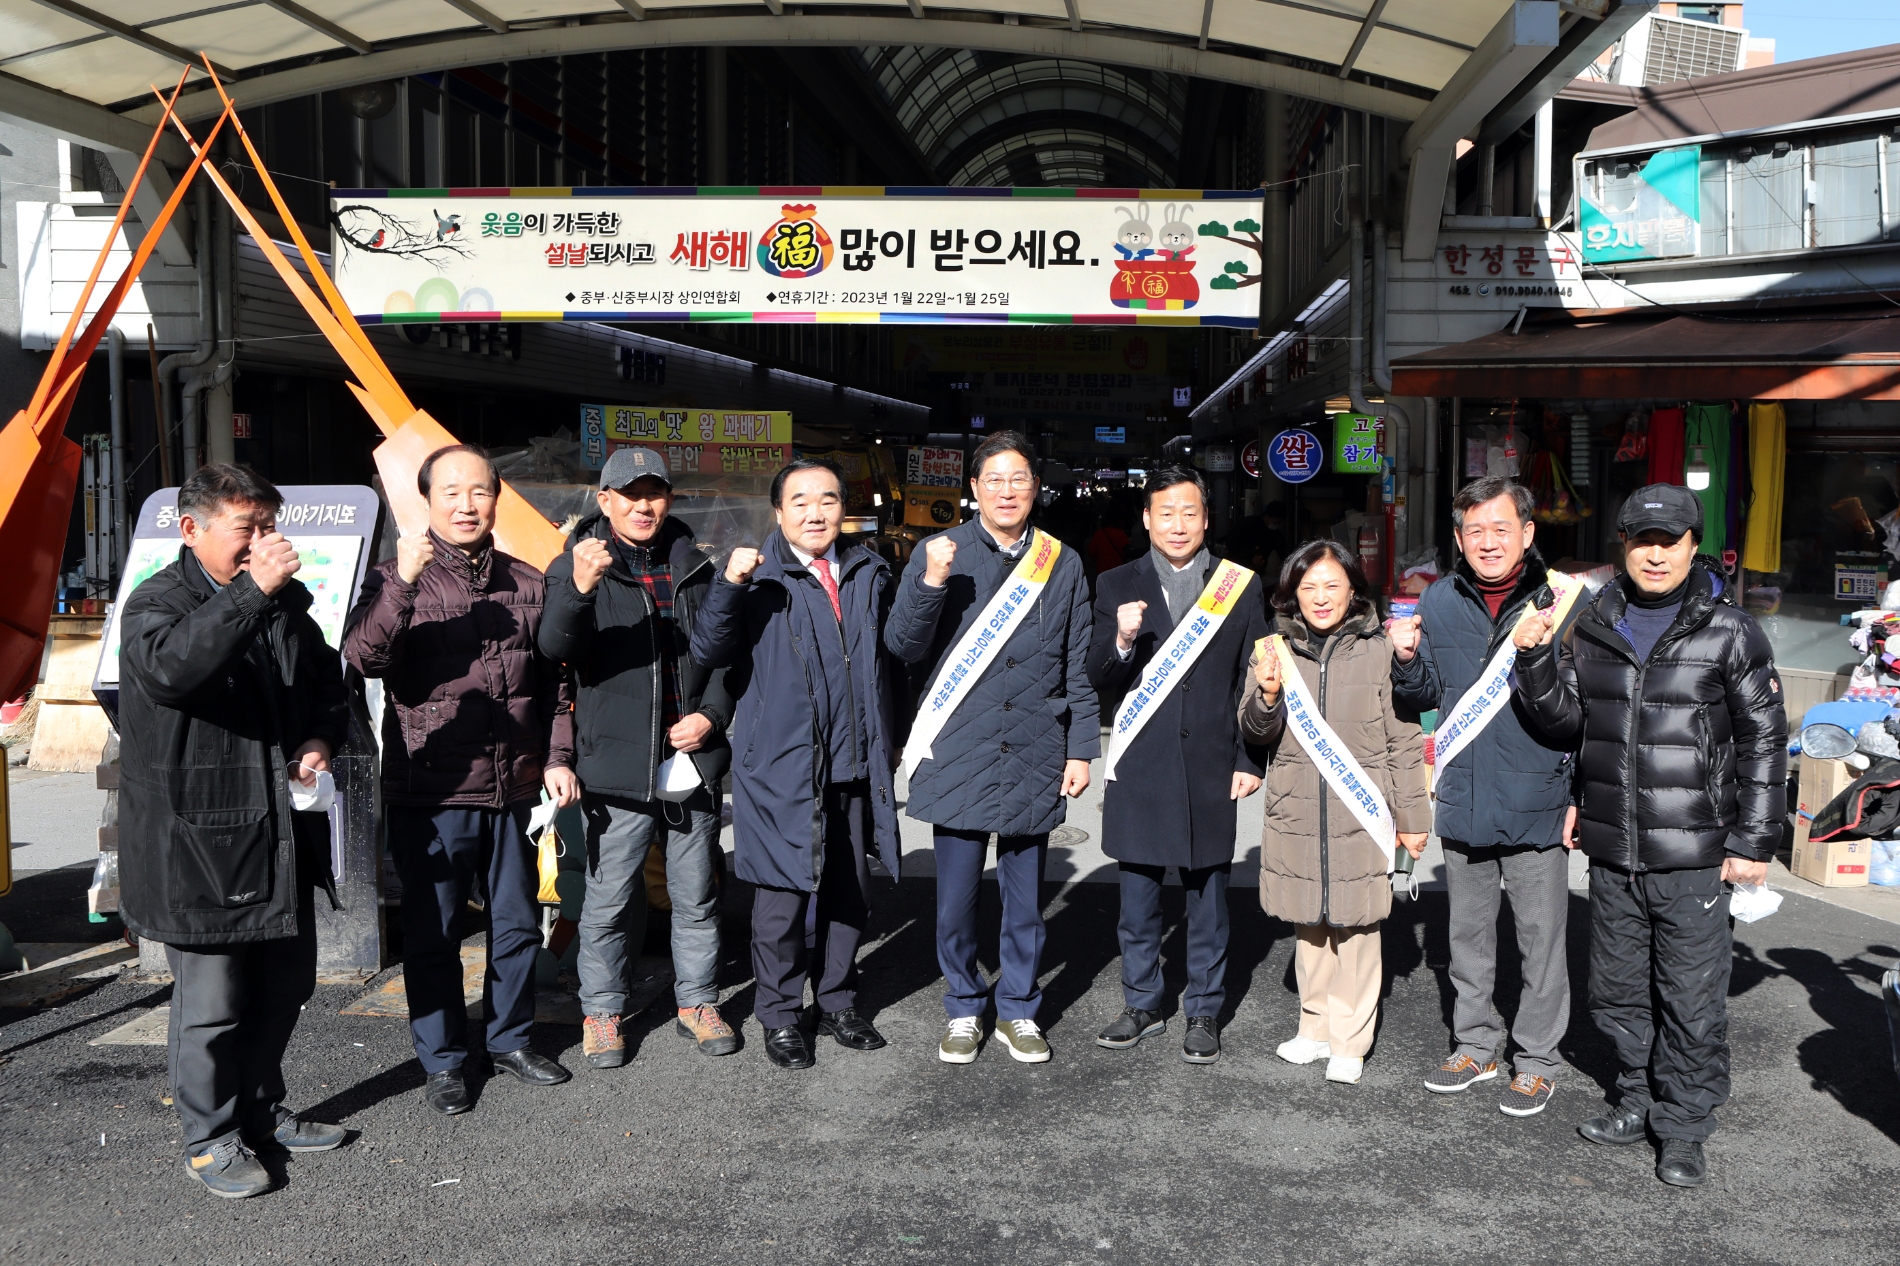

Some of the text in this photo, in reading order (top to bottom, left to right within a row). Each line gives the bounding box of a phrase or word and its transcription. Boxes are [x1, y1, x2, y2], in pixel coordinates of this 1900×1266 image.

[481, 211, 620, 236] 웃음이 가득한
[545, 243, 655, 266] 설날되시고
[670, 224, 1100, 272] 새해 福 많이 받으세요.
[1444, 244, 1575, 275] 한성문구
[678, 290, 741, 304] 상인연합회
[841, 291, 888, 305] 2023년
[893, 291, 914, 305] 1월
[980, 291, 1010, 306] 25일
[1450, 285, 1471, 296] 45호
[943, 334, 1113, 351] 온누리상품권 부정유통 근절!!
[1129, 358, 1145, 367] NO!
[1018, 388, 1110, 397] 02)2273-1006
[985, 398, 1028, 409] 우리시장은
[1033, 399, 1070, 410] 코로나19
[1076, 401, 1101, 411] 로부터
[586, 408, 603, 464] 중부
[615, 410, 659, 438] 최고의
[698, 413, 715, 441] 왕
[723, 414, 771, 442] 꽈배기
[720, 446, 784, 474] 찹쌀도넛
[923, 448, 962, 461] 꽈배기
[1276, 433, 1315, 470] 쌀
[1342, 444, 1384, 464] 참기
[908, 454, 919, 483] 원조
[922, 461, 961, 476] 찹쌀도넛
[922, 474, 961, 488] 고로케명가
[1009, 583, 1029, 605] 새해
[1856, 587, 1874, 595] 주유소
[1191, 615, 1210, 636] 새해
[961, 628, 996, 667] 받으시고
[1143, 658, 1177, 696] 받으시고
[1457, 697, 1490, 730] 받으시고
[1286, 690, 1303, 712] 새해
[1314, 738, 1348, 776] 받으시고
